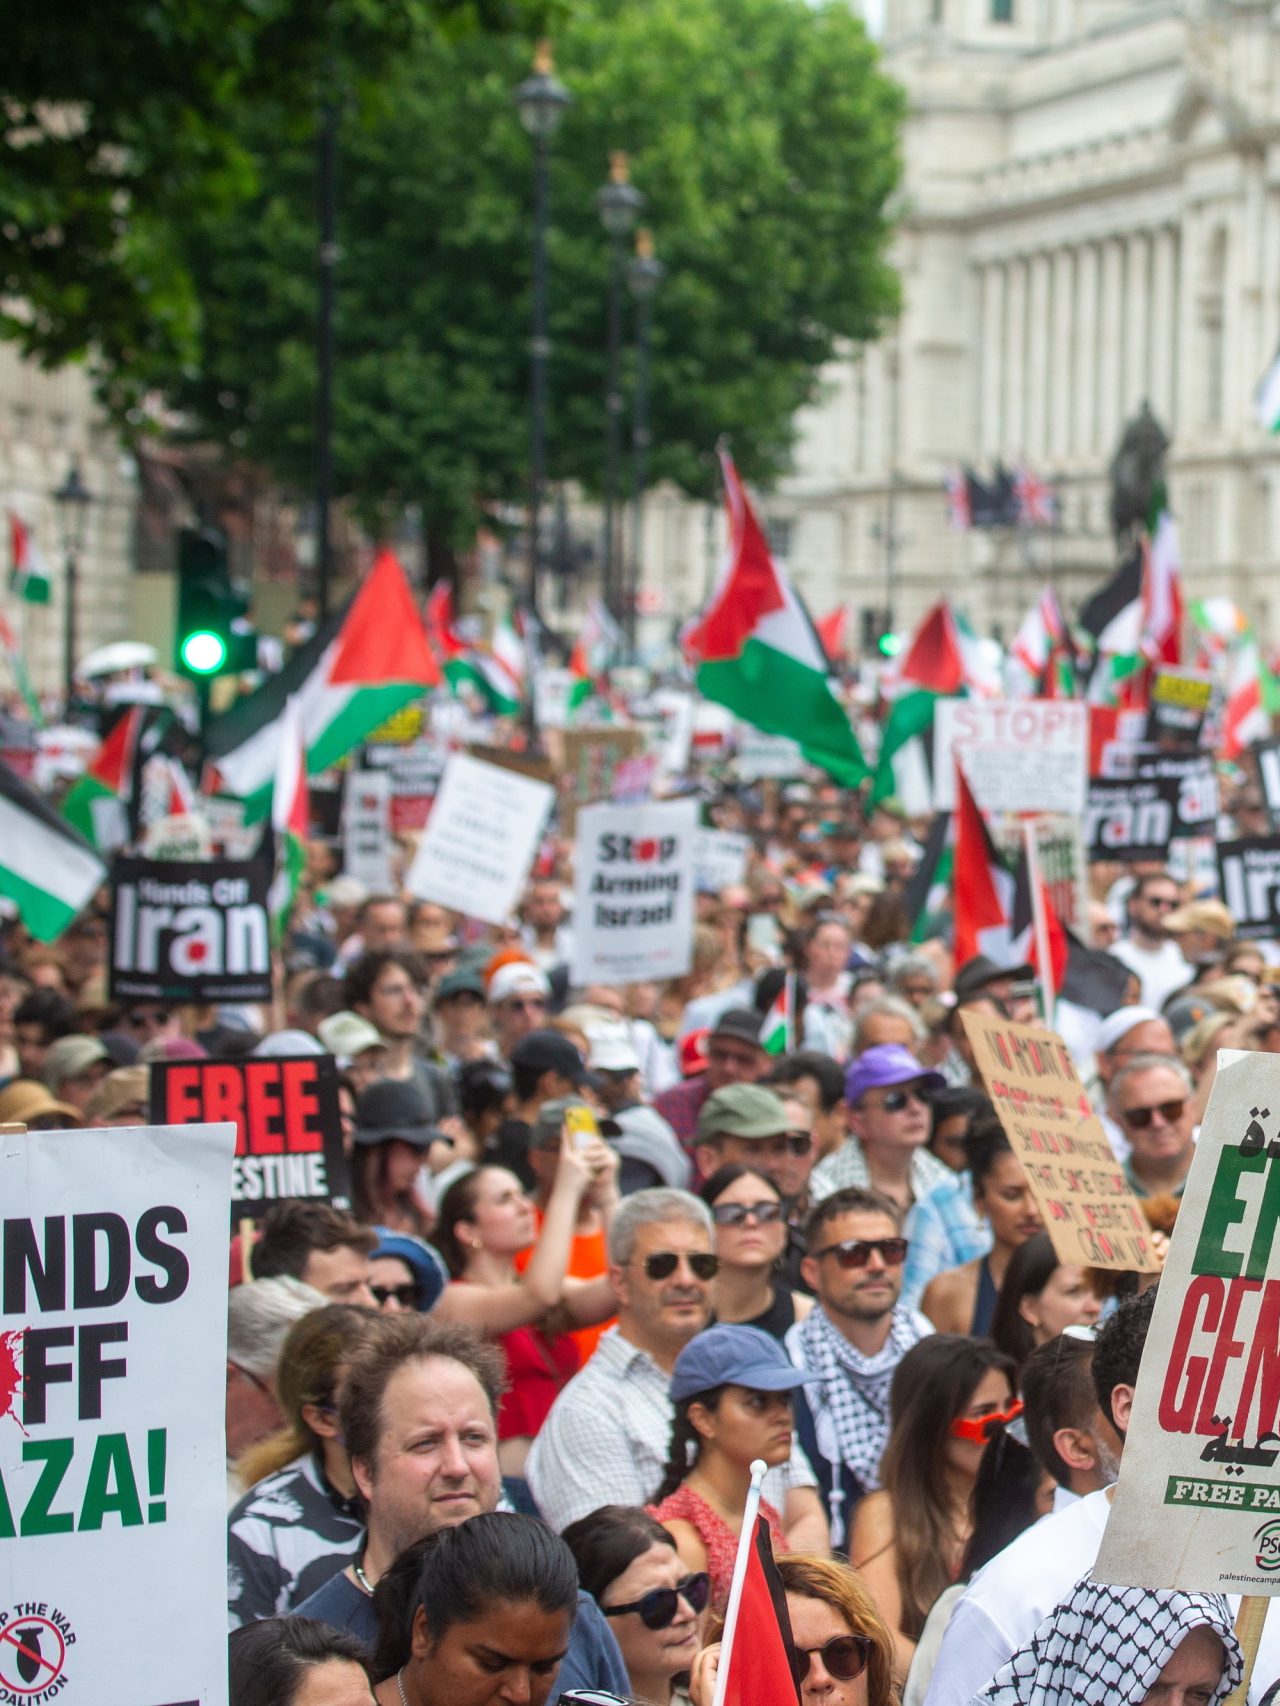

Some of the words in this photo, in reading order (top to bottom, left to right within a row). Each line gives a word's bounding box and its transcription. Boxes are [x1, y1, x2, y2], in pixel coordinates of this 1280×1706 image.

[114, 884, 271, 977] Iran
[166, 1060, 324, 1155] FREE
[1172, 1480, 1246, 1506] FREE
[14, 1601, 48, 1617] THE
[51, 1607, 76, 1647] WAR
